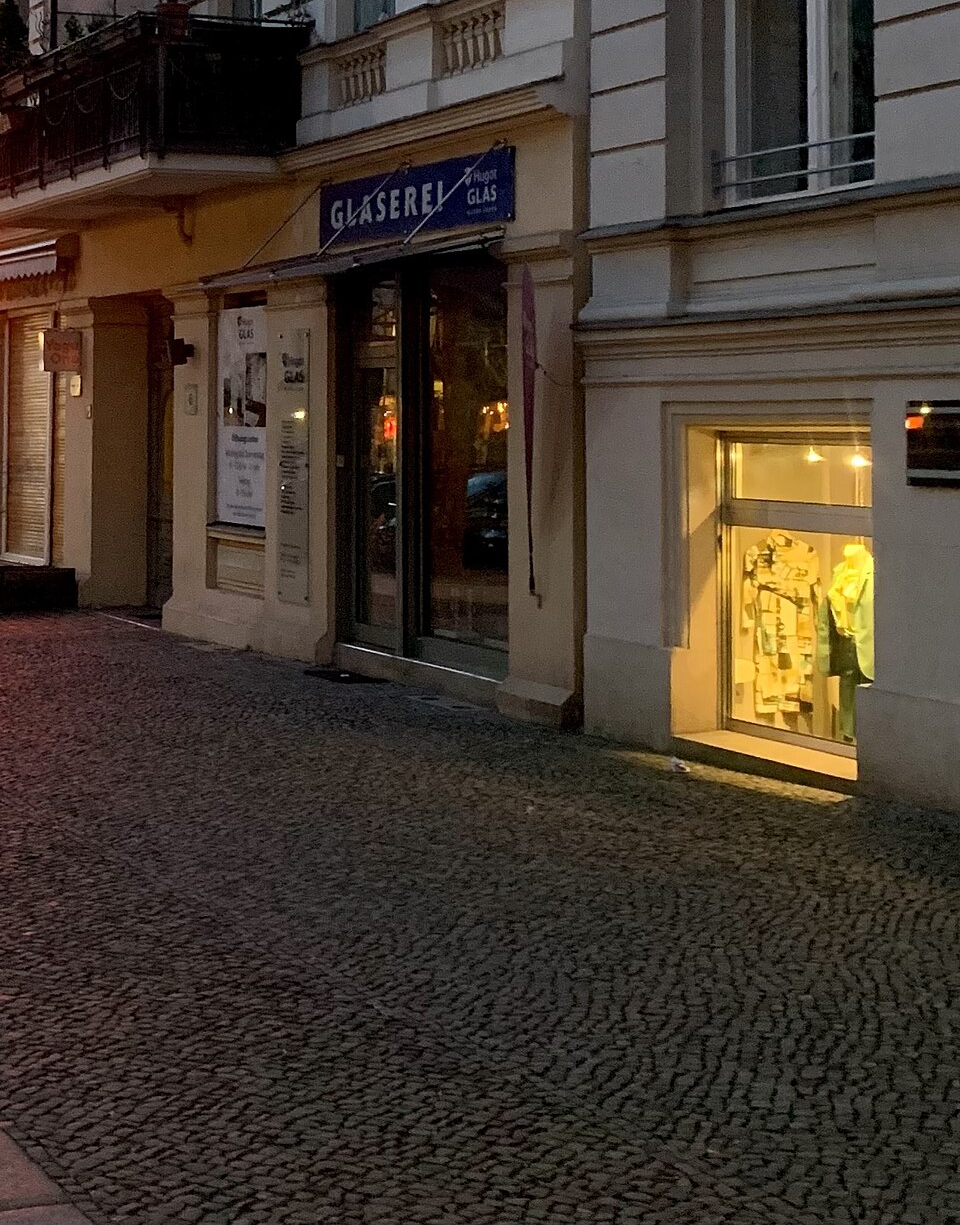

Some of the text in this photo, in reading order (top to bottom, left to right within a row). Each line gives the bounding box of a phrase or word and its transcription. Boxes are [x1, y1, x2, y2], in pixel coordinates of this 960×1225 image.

[330, 180, 444, 230] GLASEREI
[467, 184, 497, 206] GLAS
[284, 370, 305, 383] GLAS
